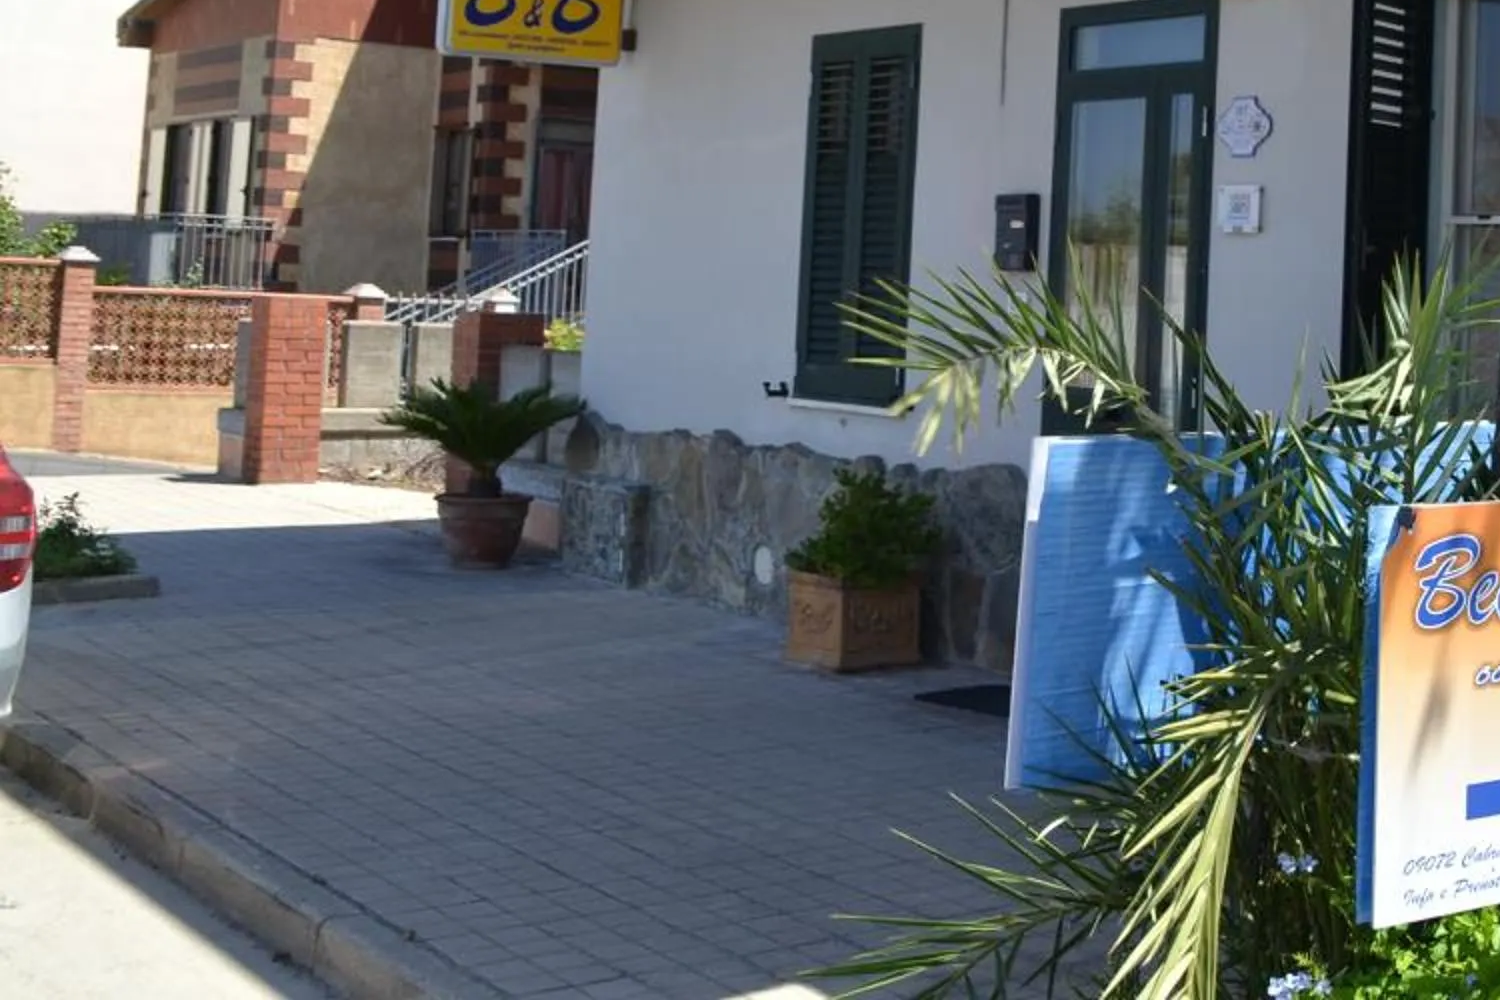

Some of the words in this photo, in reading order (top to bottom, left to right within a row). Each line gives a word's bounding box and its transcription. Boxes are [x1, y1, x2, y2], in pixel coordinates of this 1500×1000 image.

[1403, 851, 1457, 876] 09072
[1403, 887, 1435, 909] Info
[1439, 889, 1448, 899] e
